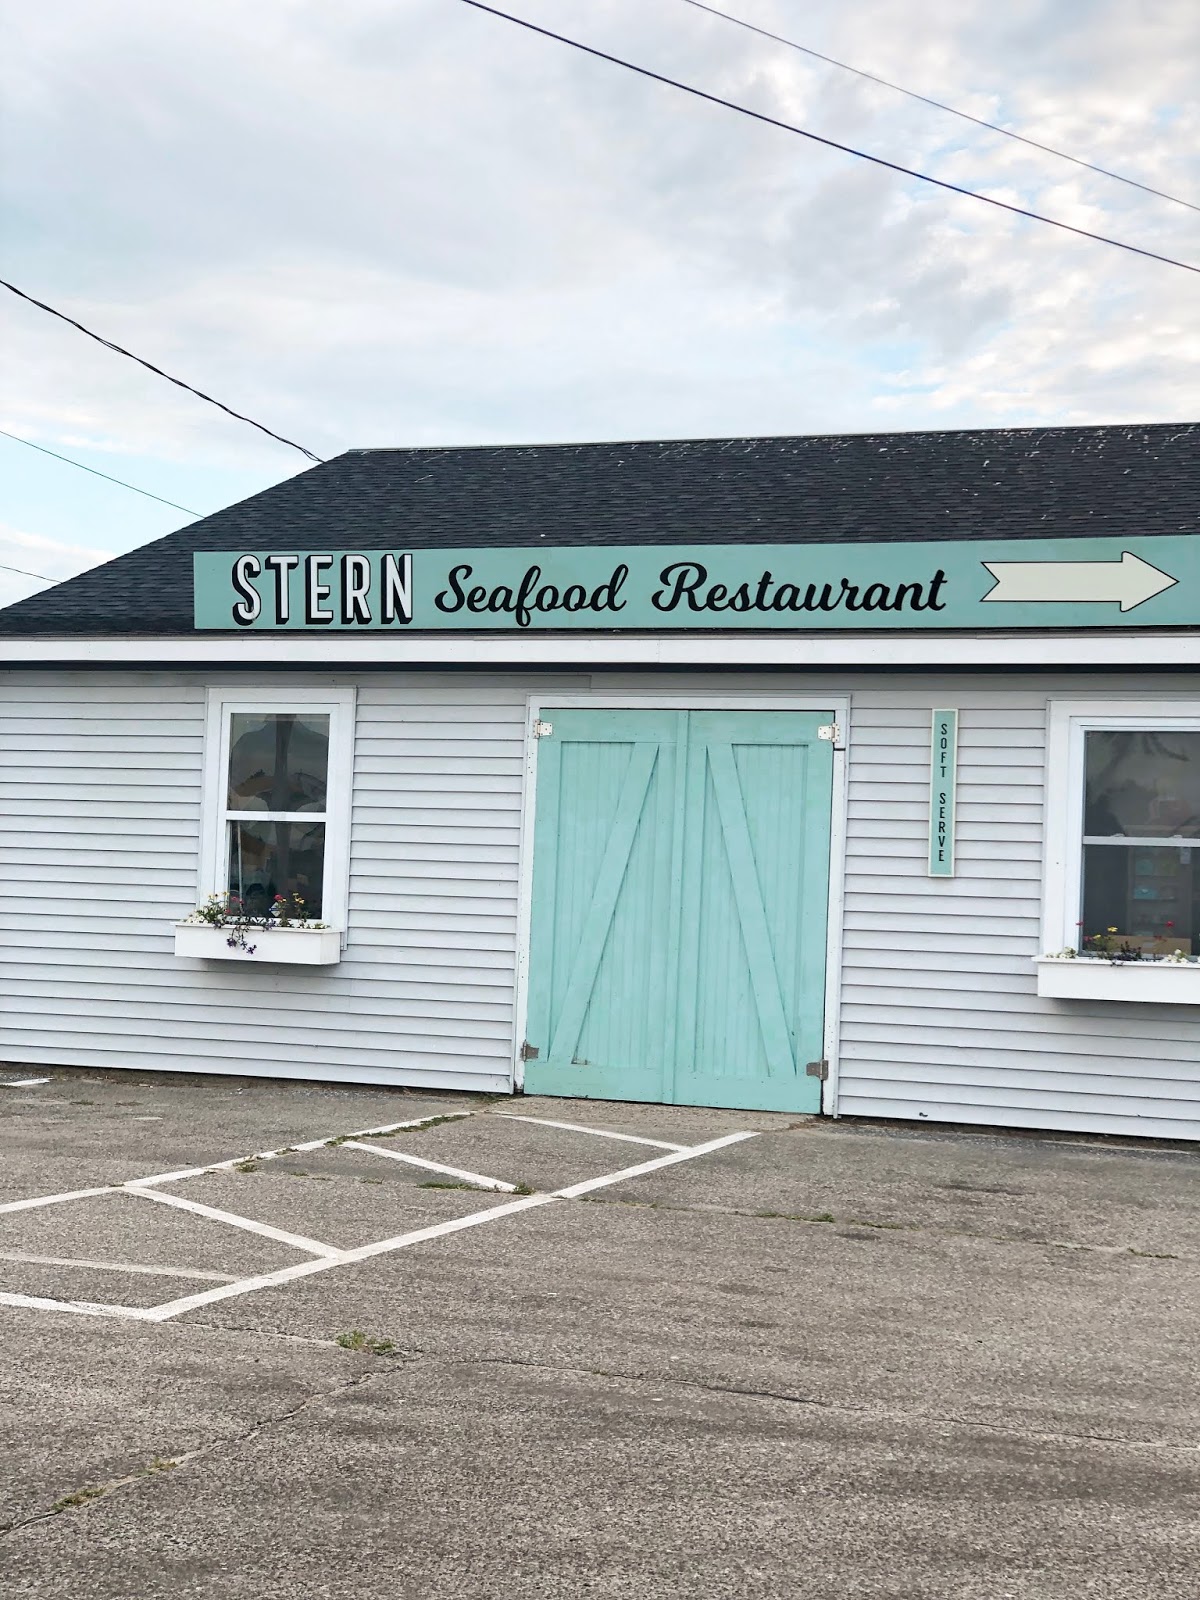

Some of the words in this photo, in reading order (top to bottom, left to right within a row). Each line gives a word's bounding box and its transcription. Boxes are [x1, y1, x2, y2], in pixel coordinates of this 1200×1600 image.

[231, 553, 414, 627] STERN
[434, 563, 629, 628] Seafood
[651, 561, 948, 613] Restaurant
[939, 722, 949, 778] SOFT
[937, 792, 947, 862] SERVE
